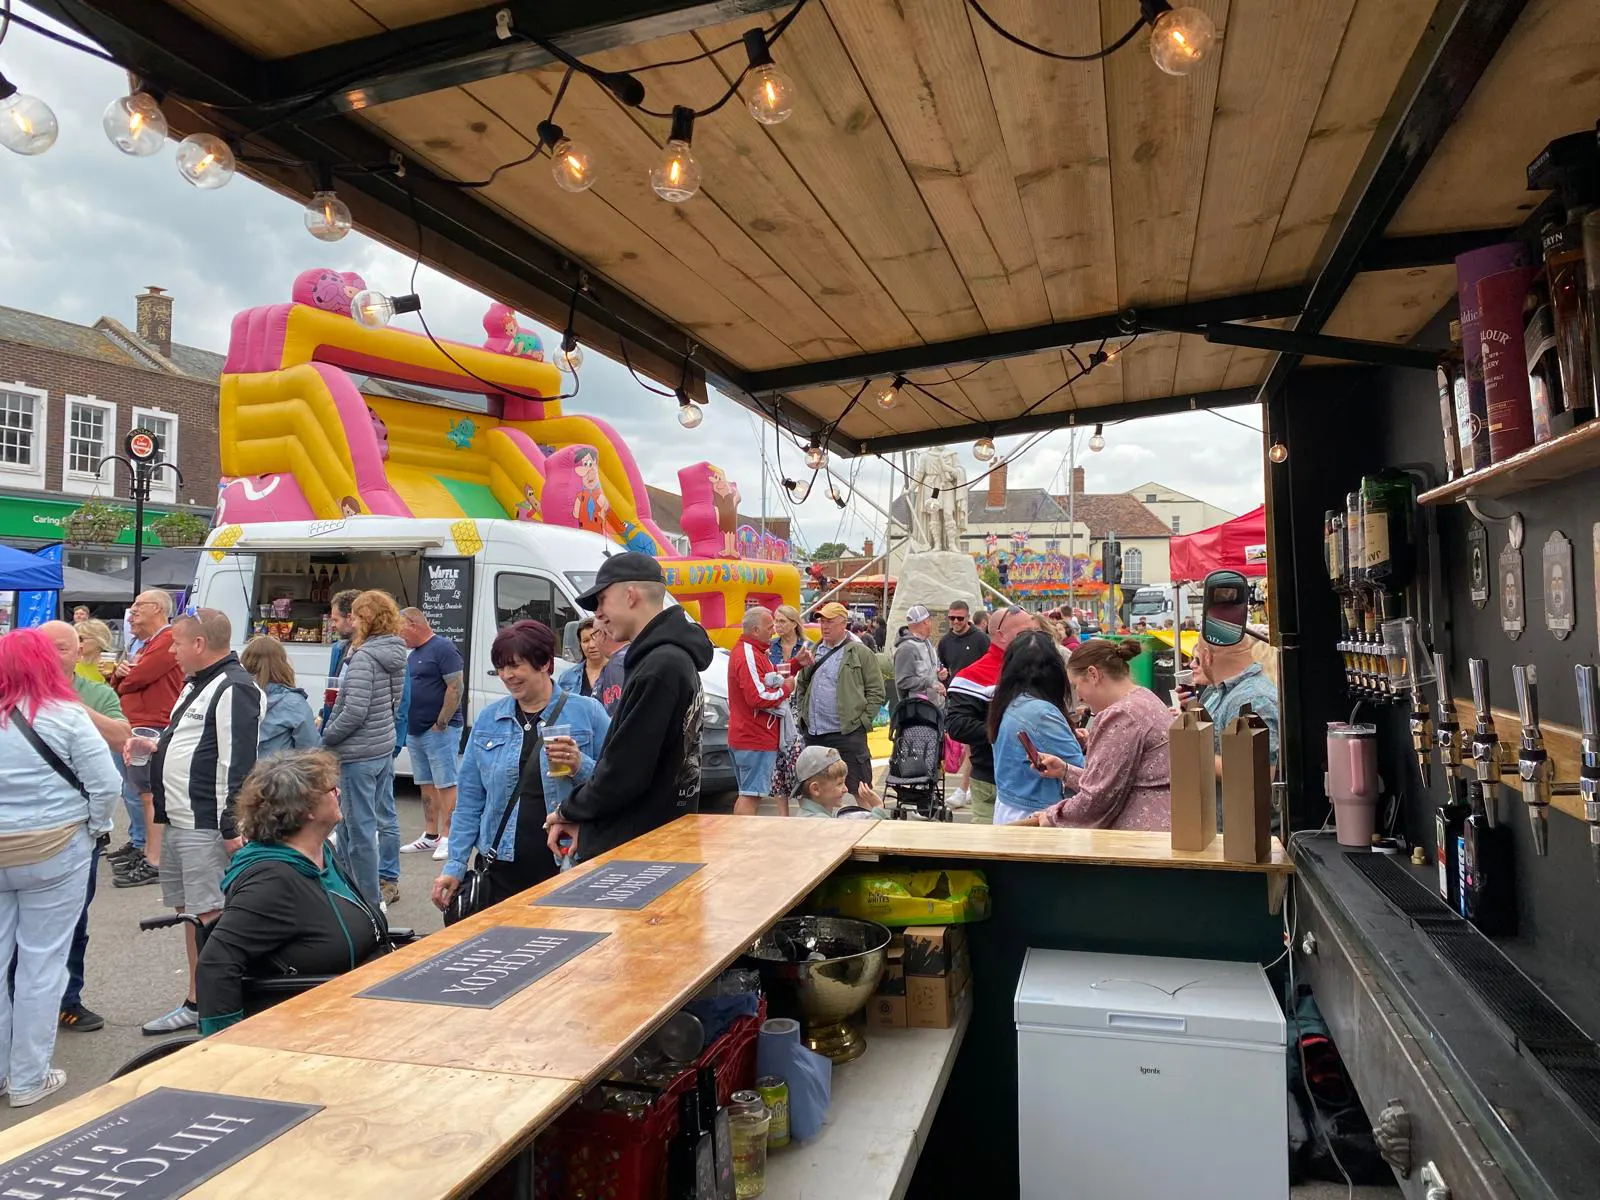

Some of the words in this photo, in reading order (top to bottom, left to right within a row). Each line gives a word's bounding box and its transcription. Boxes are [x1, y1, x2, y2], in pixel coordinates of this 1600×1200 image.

[1480, 329, 1510, 346] LOUR
[33, 515, 60, 526] Caring
[440, 935, 569, 996] HITCHCOX
[52, 1116, 130, 1157] Produced
[56, 1112, 254, 1200] HITCH
[2, 1145, 129, 1200] CIDER
